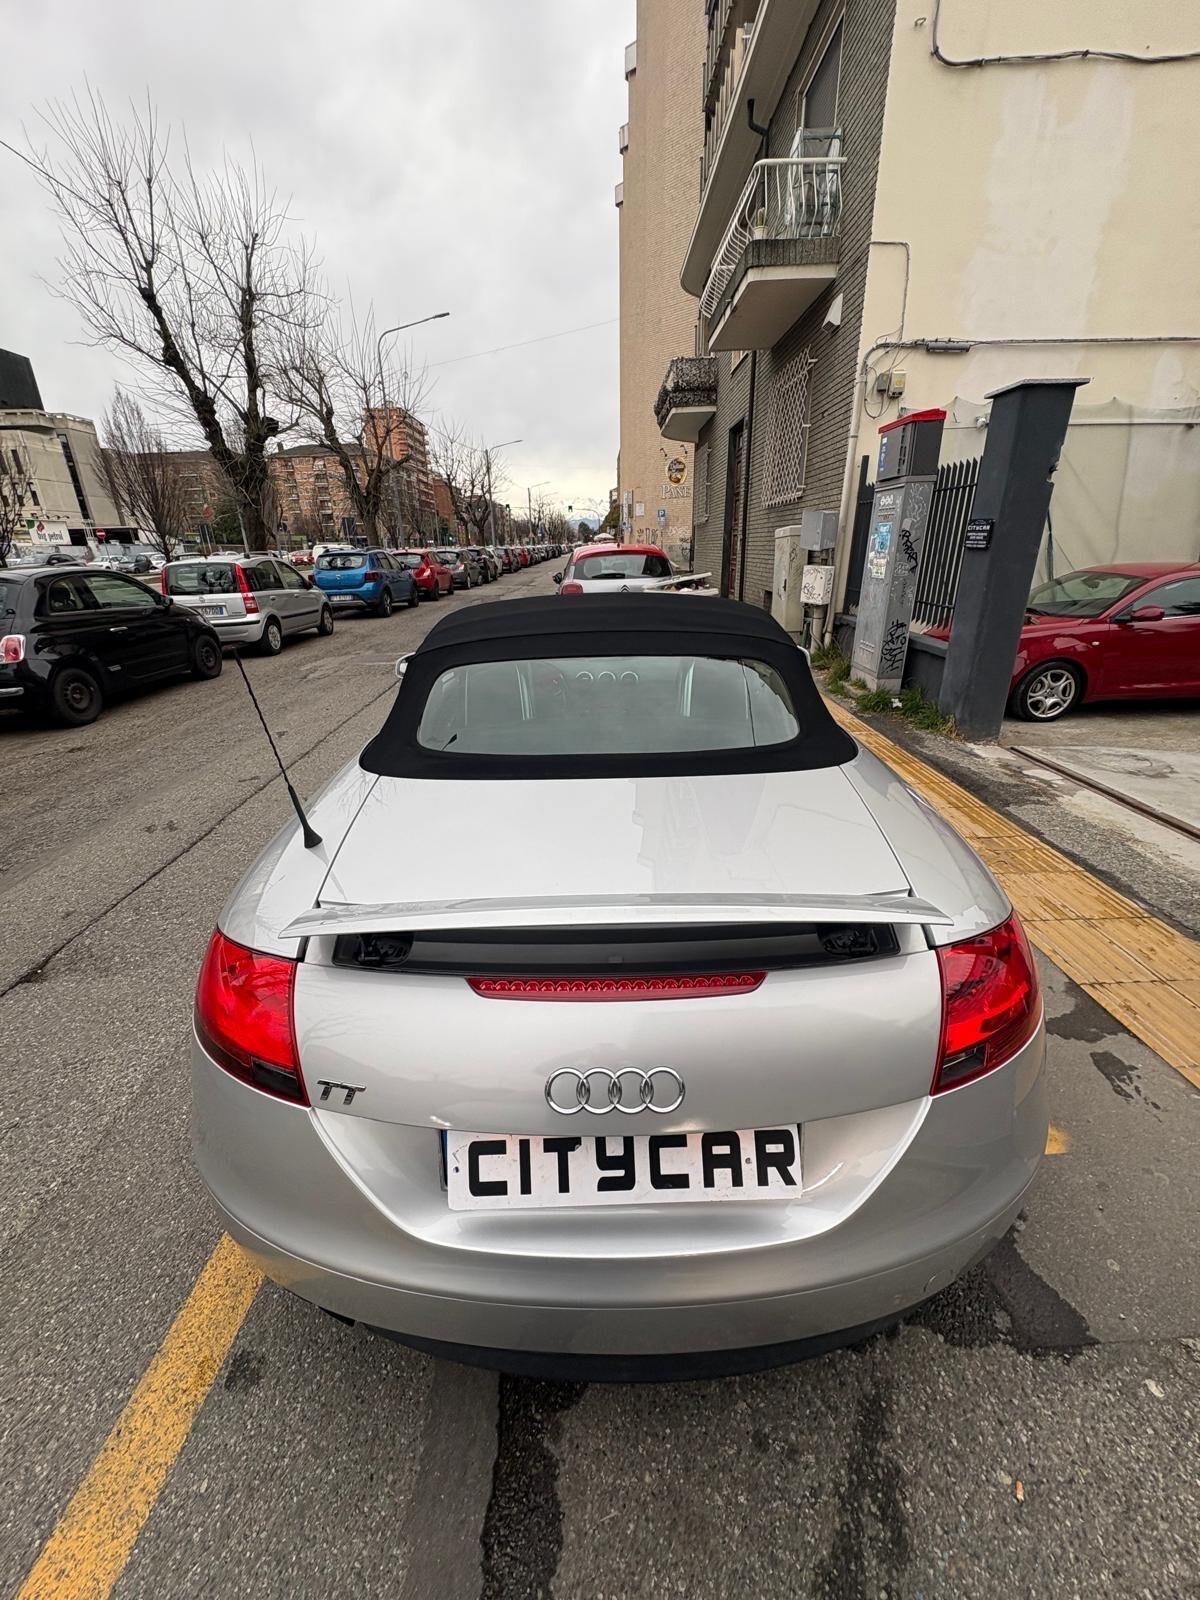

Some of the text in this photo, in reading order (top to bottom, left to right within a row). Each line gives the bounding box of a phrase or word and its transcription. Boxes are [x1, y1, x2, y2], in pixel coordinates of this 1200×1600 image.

[661, 484, 691, 499] PANE
[317, 1078, 367, 1105] TT
[468, 1129, 797, 1196] CITYCAR
